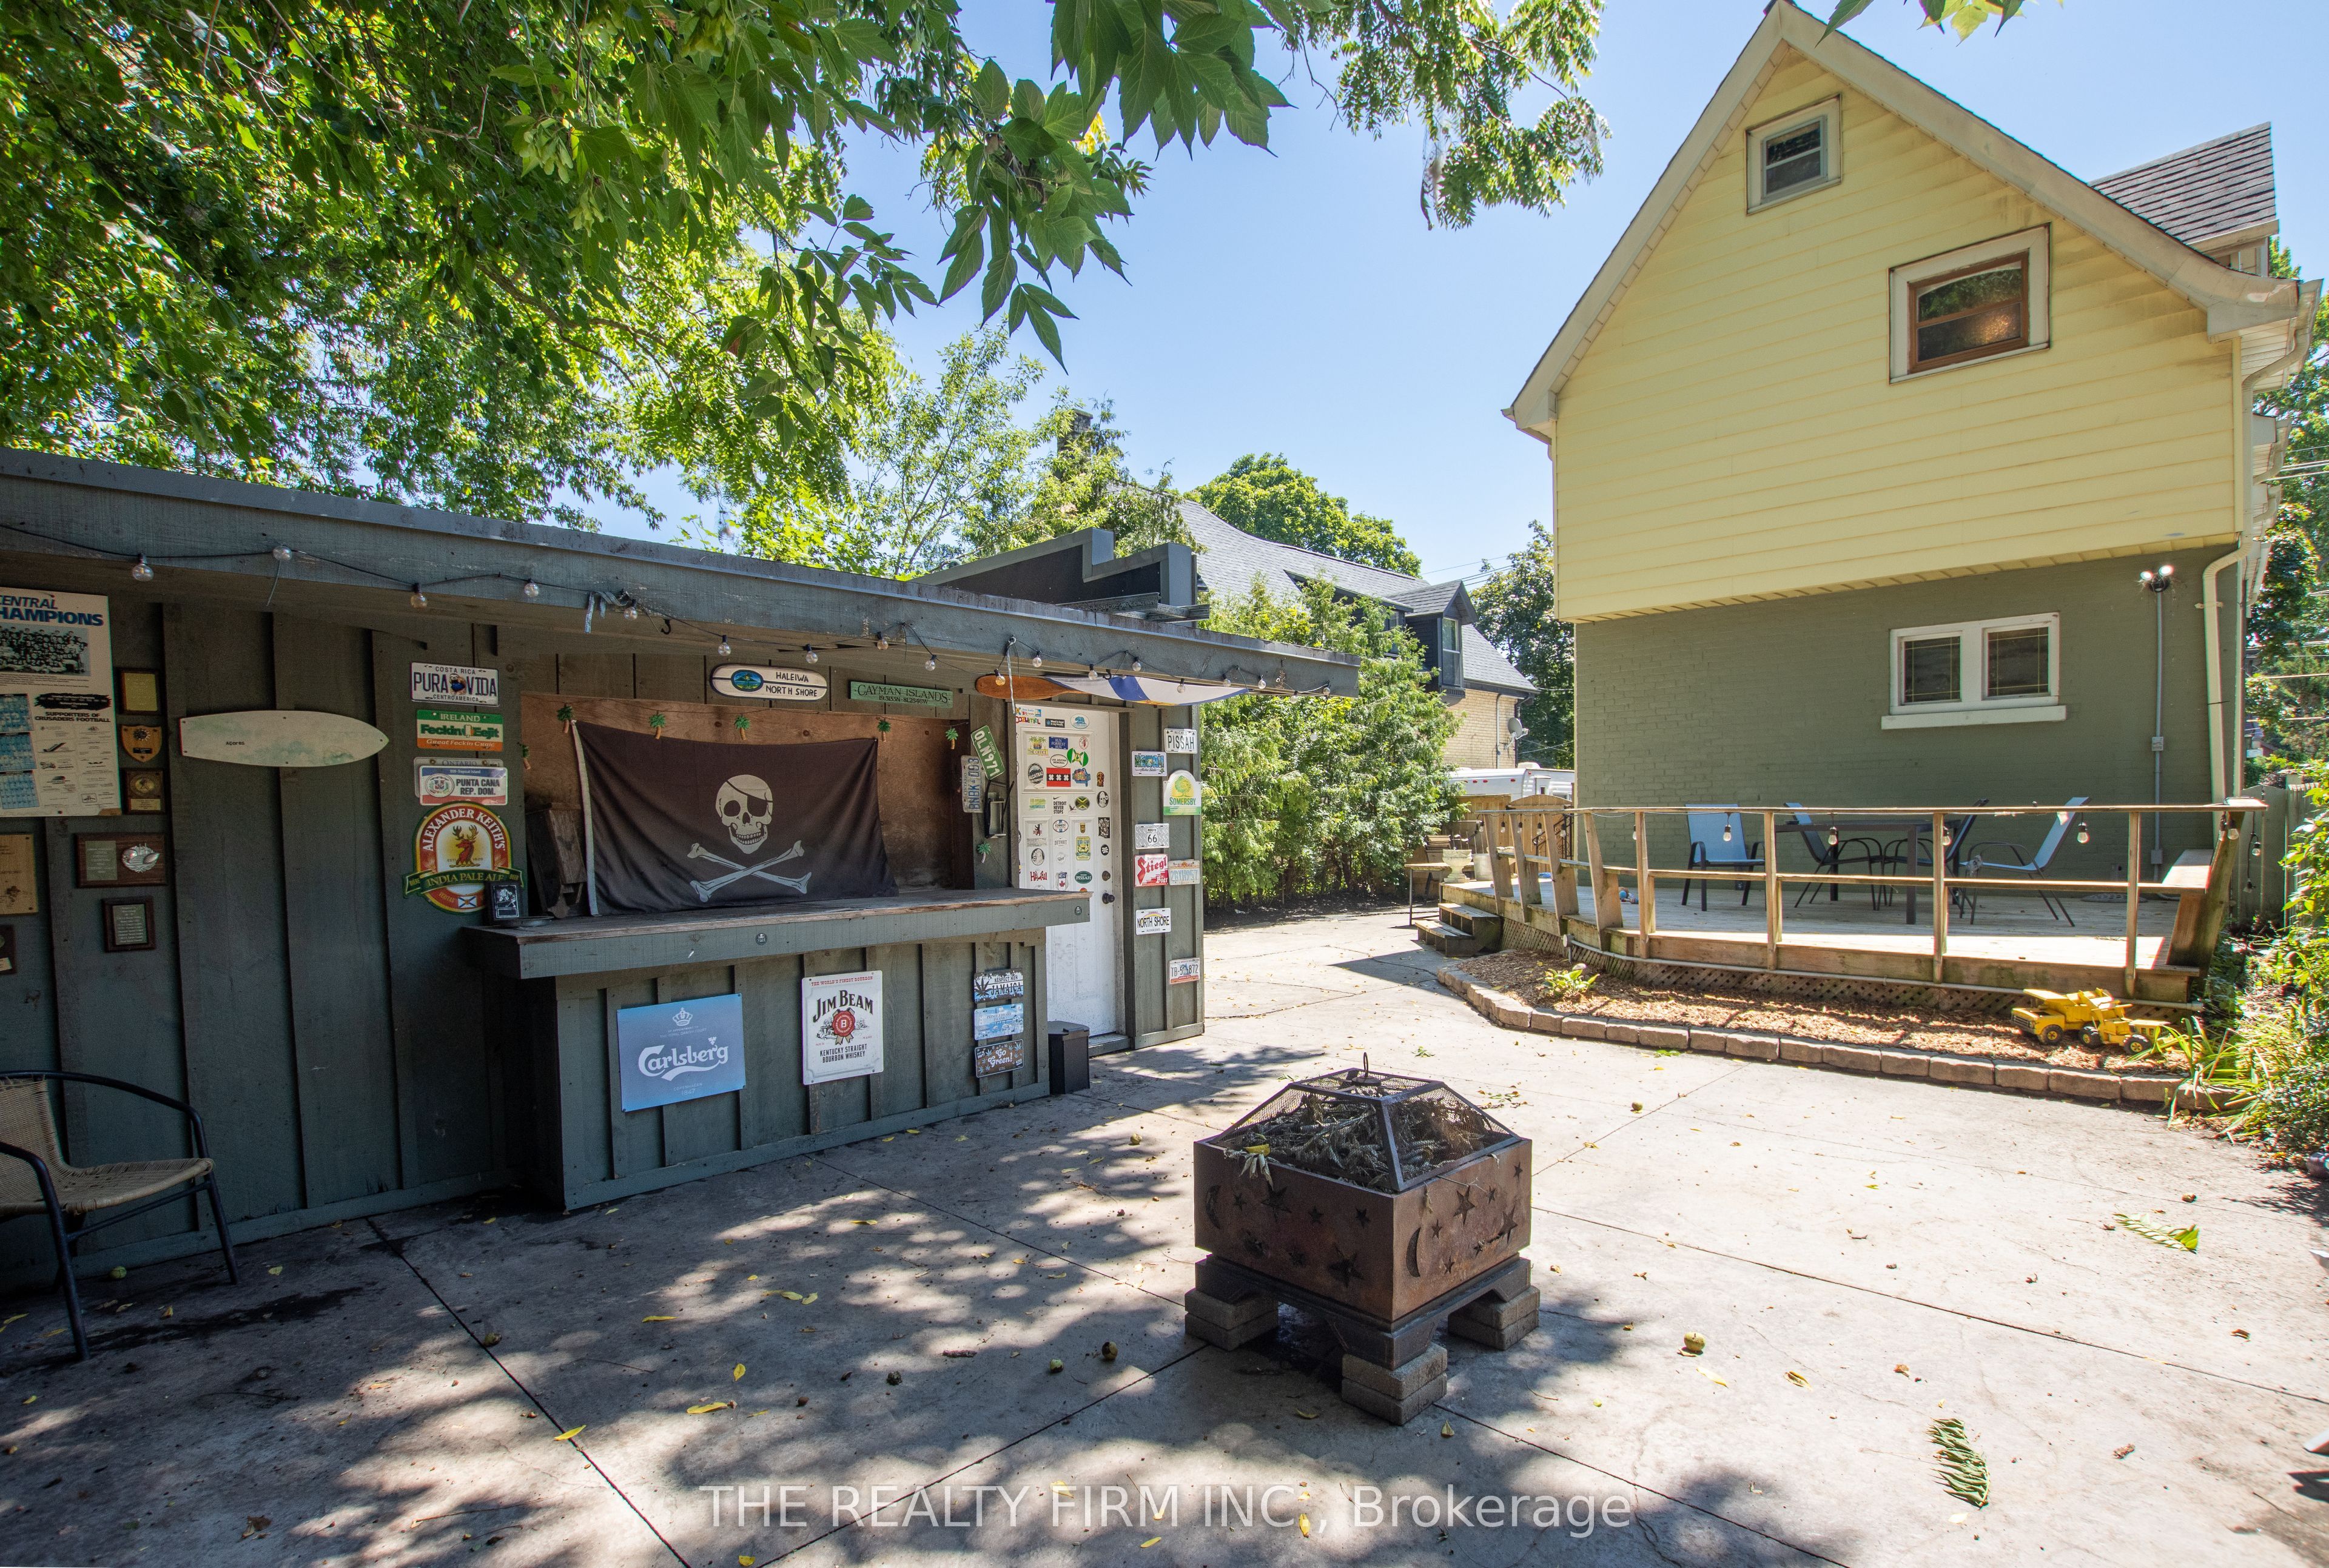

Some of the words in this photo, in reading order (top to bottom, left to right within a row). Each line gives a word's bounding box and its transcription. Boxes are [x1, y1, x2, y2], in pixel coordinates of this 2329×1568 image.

[0, 595, 58, 609] ENTRAL
[775, 672, 809, 682] HALEIWA
[413, 672, 449, 693] PURA
[466, 676, 497, 697] VIDA
[765, 685, 793, 695] NORTH
[795, 688, 818, 697] SHORE
[857, 684, 901, 696] CAYMAN
[906, 689, 948, 703] ISLANDS
[440, 713, 480, 722] IRELAND
[420, 723, 463, 735] Feckin
[1168, 735, 1194, 749] PISSAH
[1135, 755, 1164, 768] HAWAII
[1169, 797, 1196, 806] SOMERSBY
[423, 808, 475, 851] ALEXANDER
[476, 811, 506, 850] KEITH'S
[1148, 834, 1157, 843] 66
[1030, 871, 1047, 881] HAWAII
[1137, 857, 1167, 885] Stiegl
[427, 874, 459, 887] INDIA
[460, 873, 483, 881] PALE
[1137, 917, 1153, 928] NORTH
[1154, 916, 1169, 926] SHORE
[991, 982, 1022, 995] JAMAICA
[813, 996, 837, 1022] JIM
[839, 990, 873, 1015] BEAM
[841, 1019, 847, 1028] B
[820, 1047, 844, 1057] KENTUCKY
[845, 1044, 867, 1053] STRAIGHT
[822, 1053, 844, 1063] BOURBON
[845, 1050, 865, 1060] WHISKEY
[995, 1048, 1006, 1058] Go
[638, 1044, 728, 1081] Carlsberg
[987, 1052, 1013, 1068] Green!
[674, 1082, 702, 1091] COPENHAGEN
[681, 1088, 696, 1096] 1847
